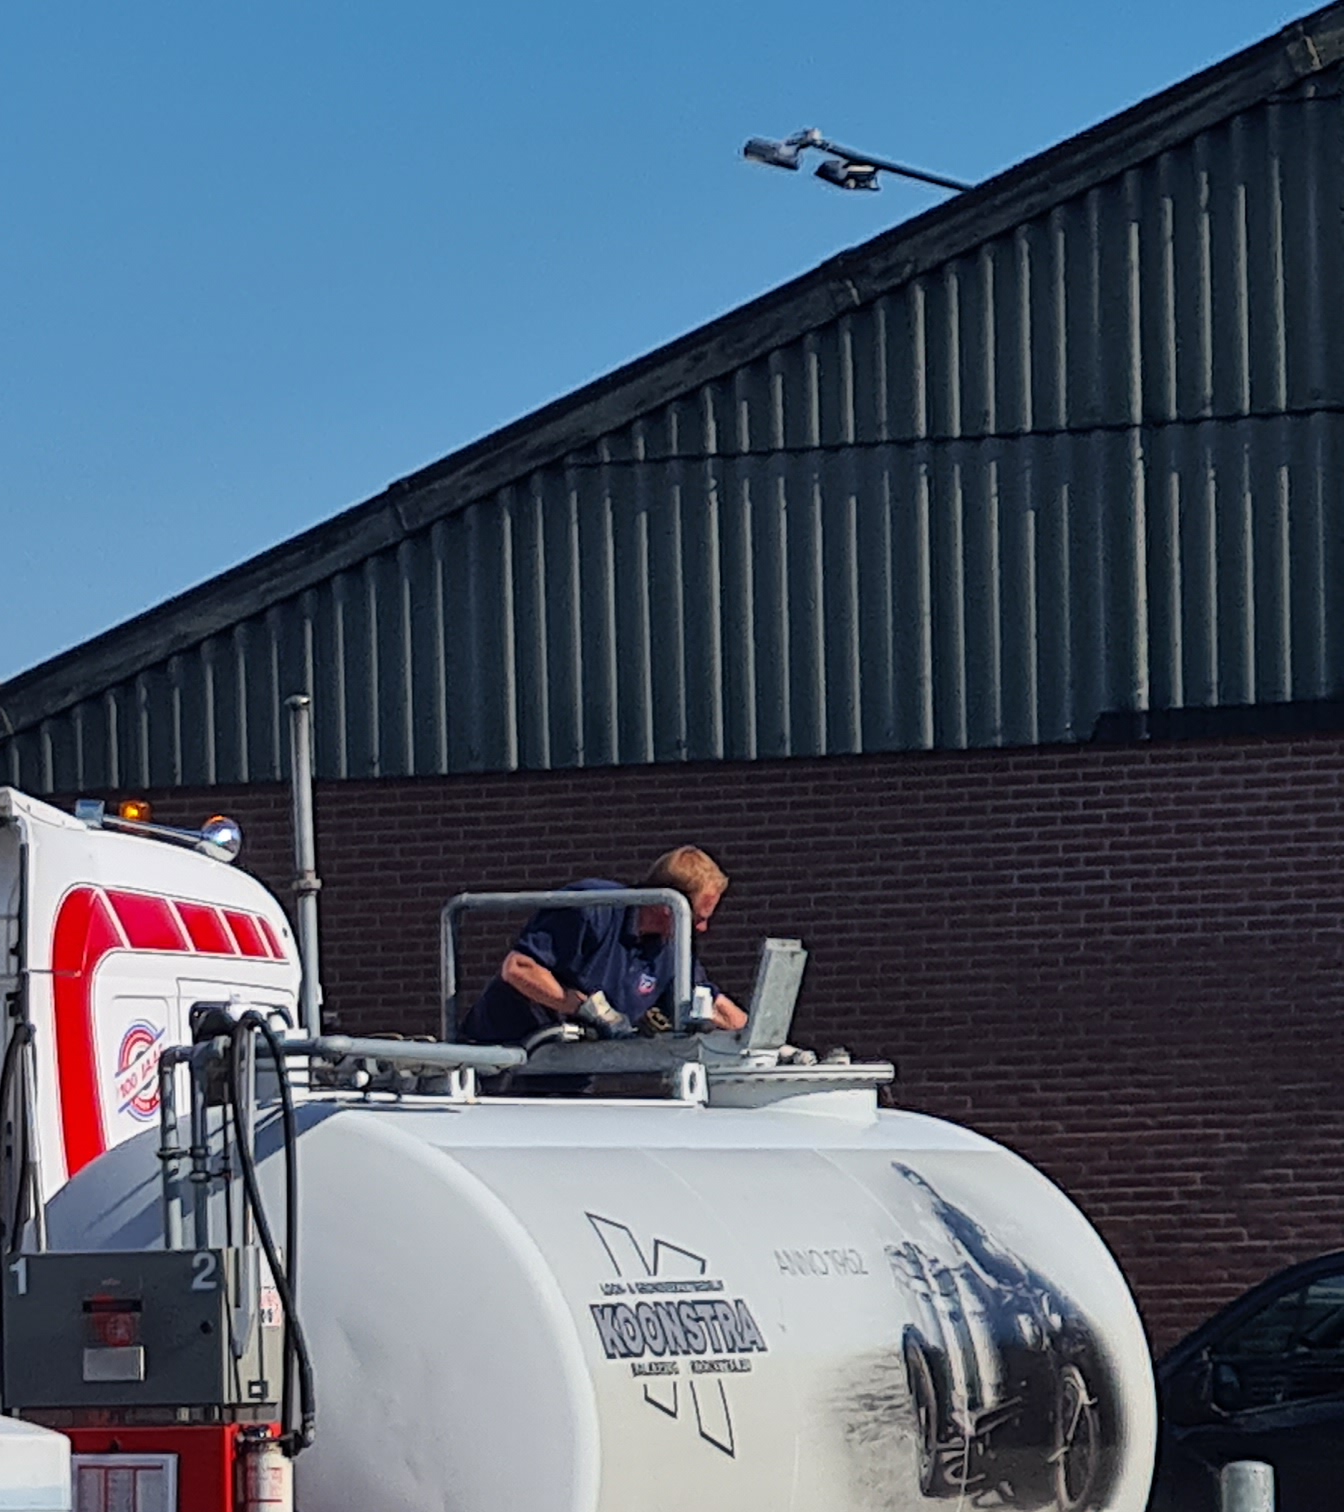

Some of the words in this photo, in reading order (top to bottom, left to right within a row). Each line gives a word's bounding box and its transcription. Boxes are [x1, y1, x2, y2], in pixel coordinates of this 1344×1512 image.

[9, 1257, 28, 1295] 1
[191, 1252, 217, 1290] 2
[588, 1298, 770, 1360] KOONSTRA
